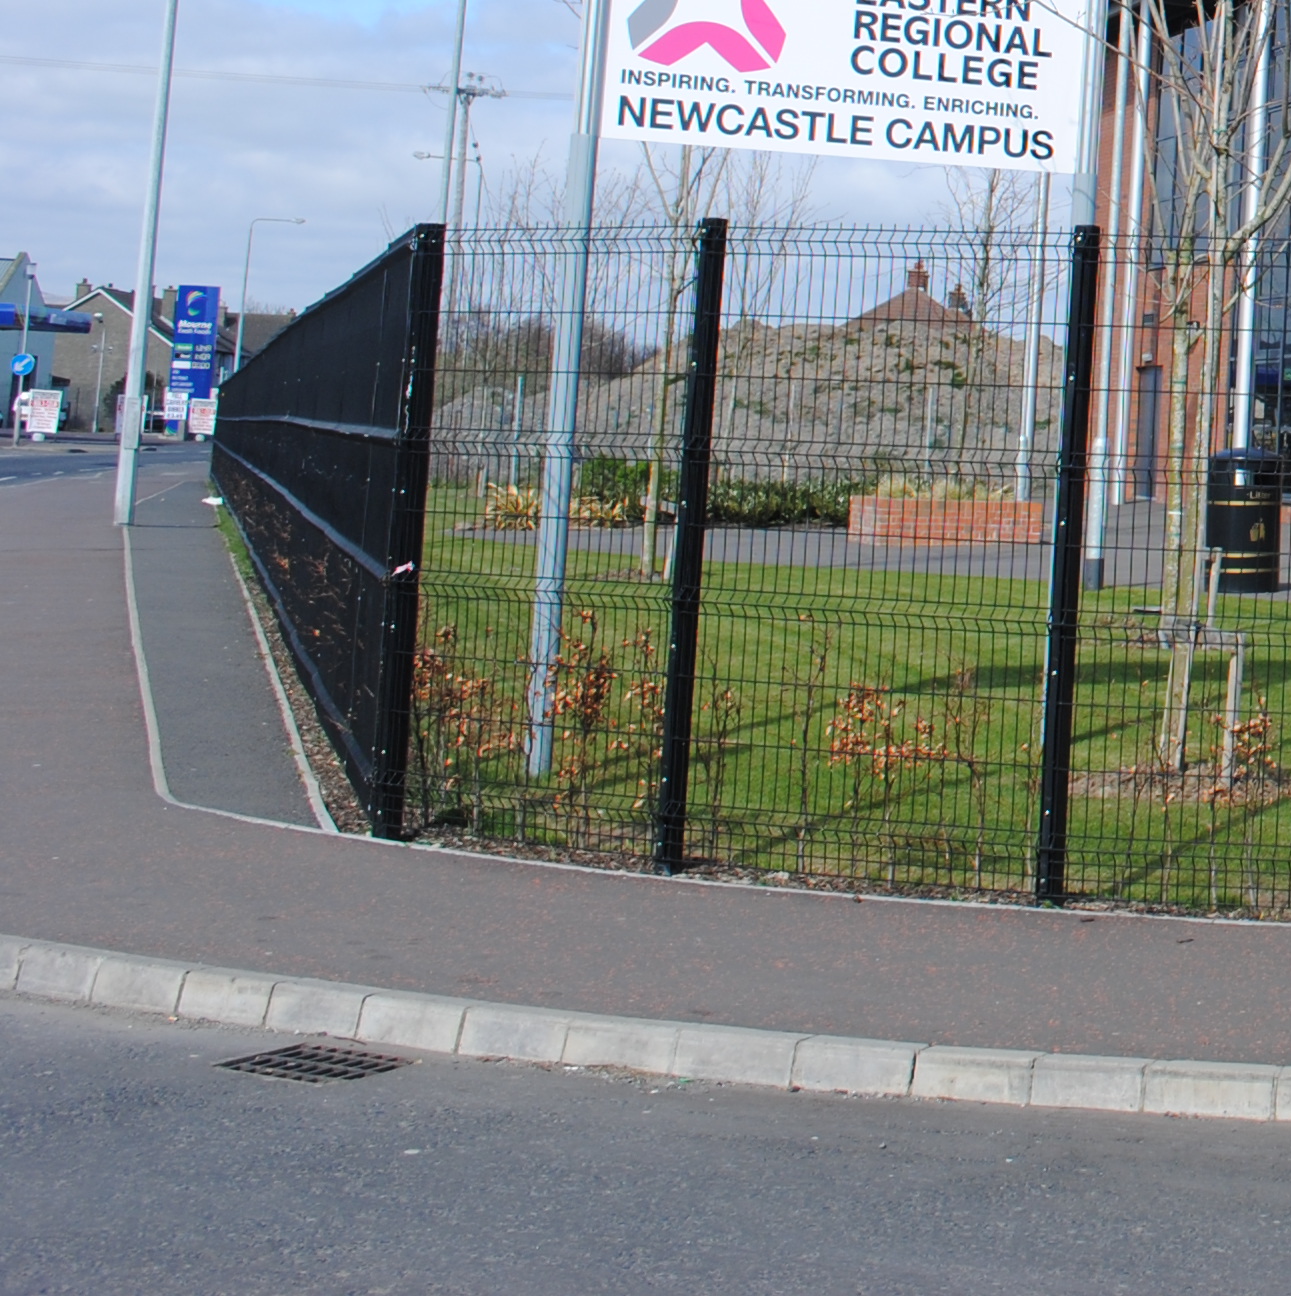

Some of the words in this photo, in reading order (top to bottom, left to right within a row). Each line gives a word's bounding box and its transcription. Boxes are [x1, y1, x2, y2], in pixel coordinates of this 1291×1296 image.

[853, 10, 1053, 59] REGIONAL
[850, 44, 1040, 91] COLLEGE
[621, 68, 737, 95] INSPIRING.
[744, 80, 916, 110] TRANSFORMING.
[923, 96, 1039, 120] ENRICHING.
[617, 95, 875, 147] NEWCASTLE
[885, 117, 1056, 161] CAMPUS
